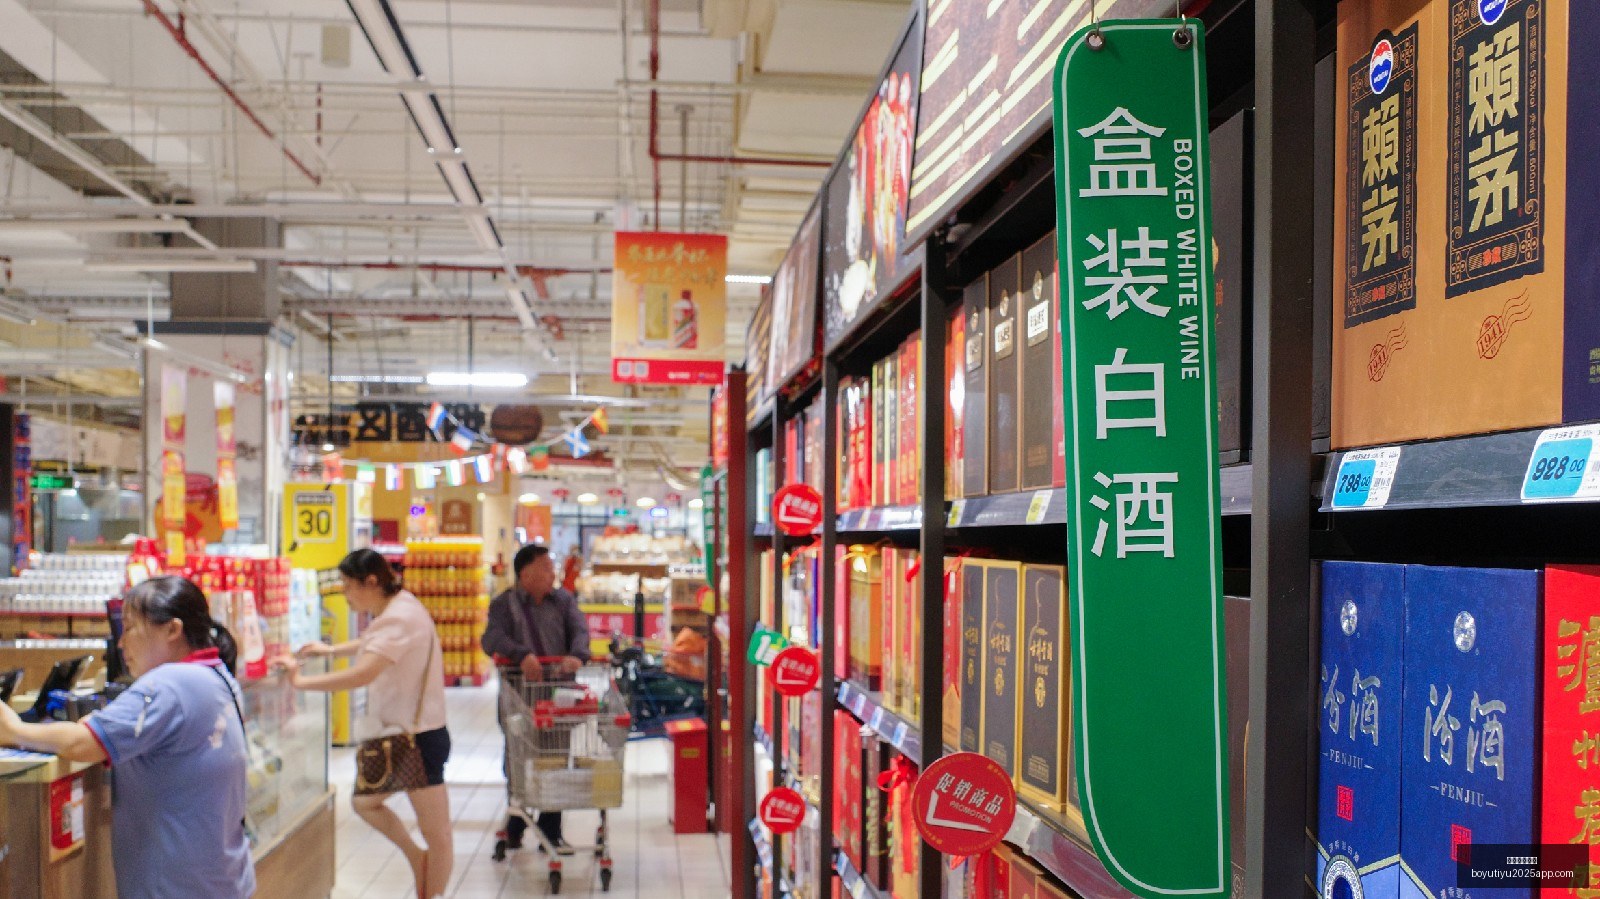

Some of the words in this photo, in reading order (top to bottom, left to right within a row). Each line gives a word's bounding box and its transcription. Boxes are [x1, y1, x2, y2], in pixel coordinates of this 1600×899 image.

[1173, 139, 1194, 220] BOXED
[1176, 229, 1197, 307] WHITE
[1077, 106, 1178, 558] 盒装白酒
[1480, 322, 1502, 352] 1941
[1179, 315, 1199, 379] WINE
[1369, 351, 1386, 376] 1941
[1532, 456, 1569, 481] 928
[1339, 473, 1361, 493] 798
[300, 510, 330, 535] 30
[1423, 684, 1506, 781] 汾酒
[1329, 749, 1363, 769] FENJIU
[935, 772, 1004, 816] 促销商品
[1440, 782, 1484, 808] FENJIU
[950, 800, 991, 823] PROMOTION
